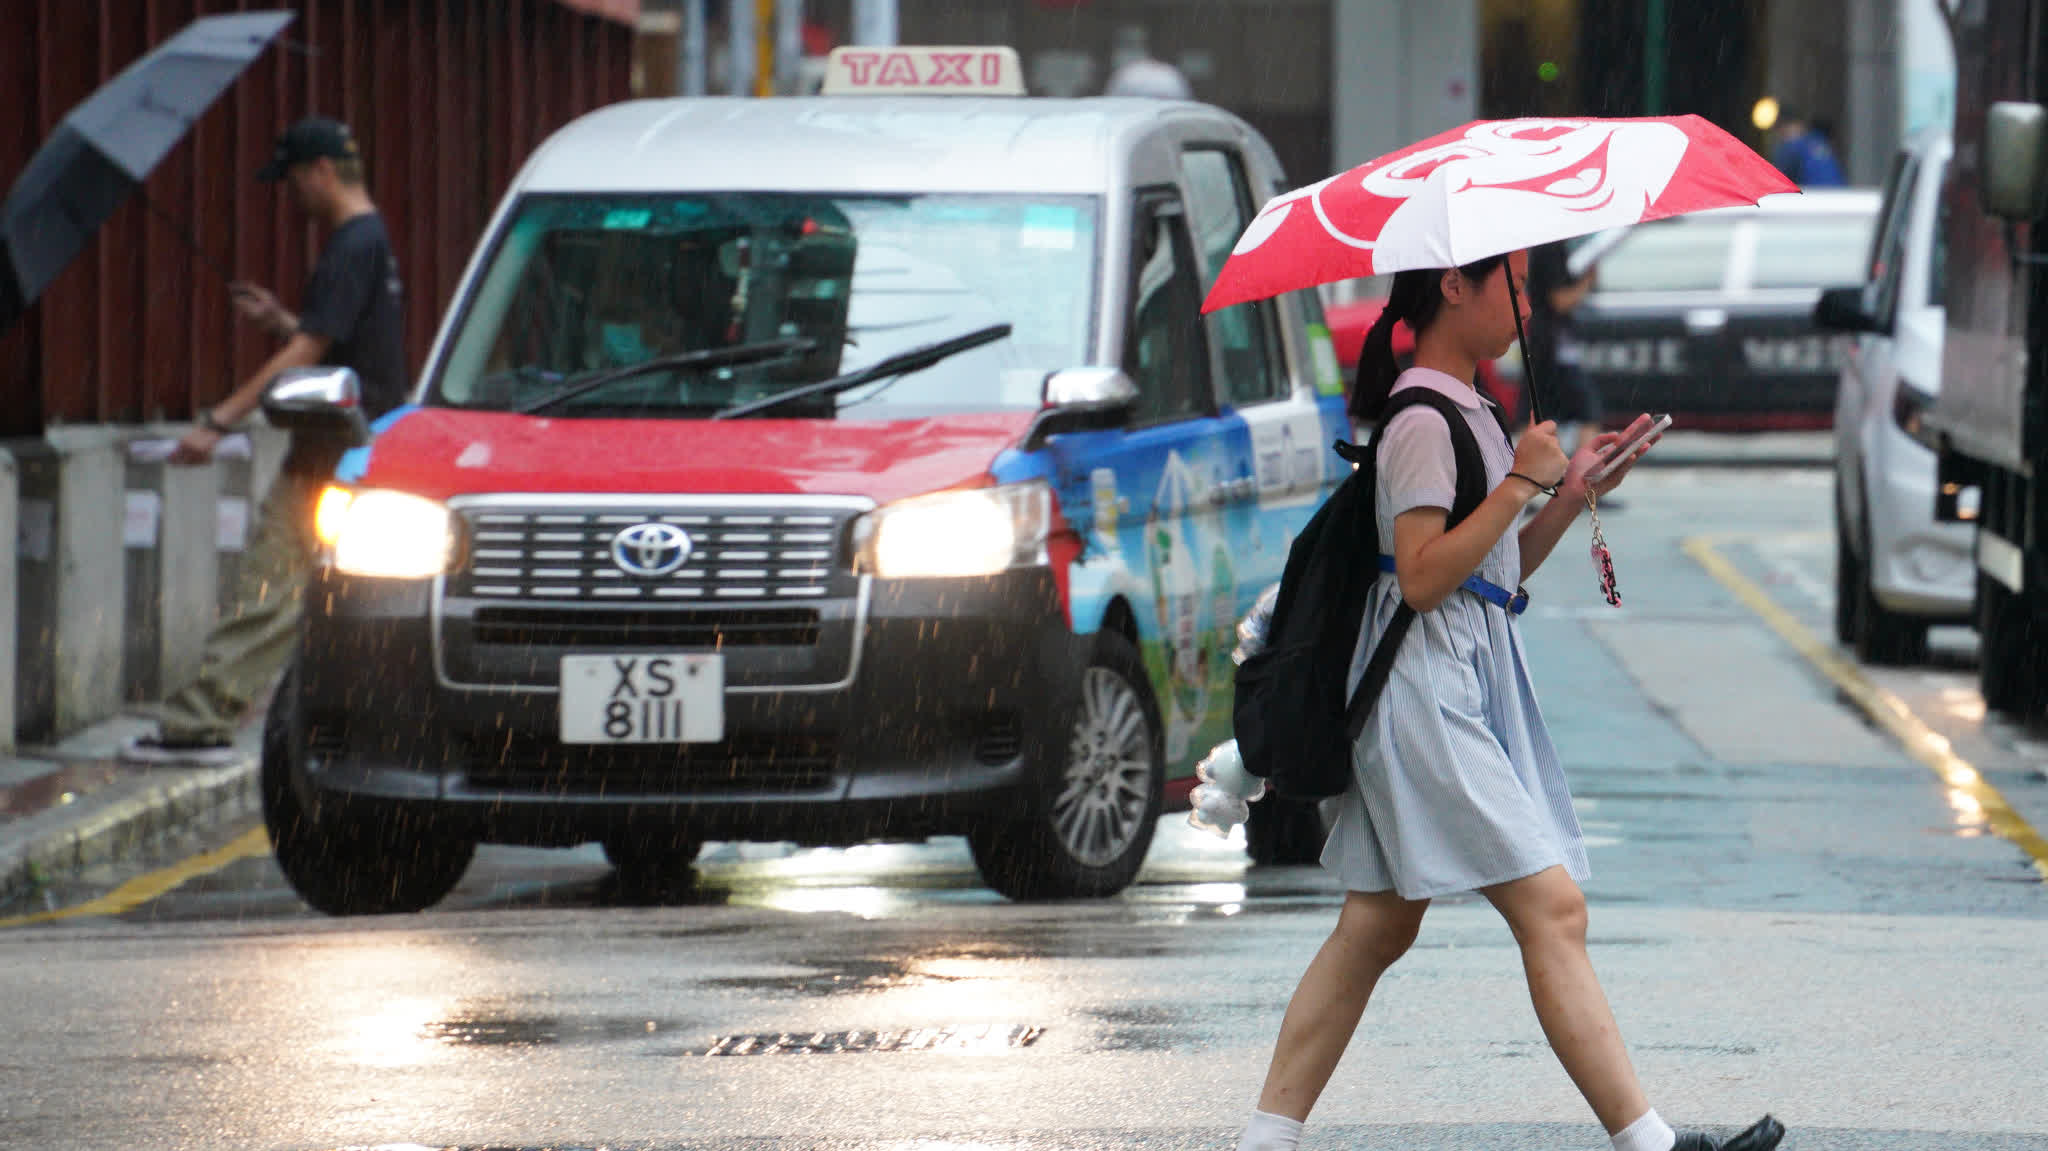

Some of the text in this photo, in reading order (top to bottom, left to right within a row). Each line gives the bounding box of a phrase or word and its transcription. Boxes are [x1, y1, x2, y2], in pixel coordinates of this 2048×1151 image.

[841, 52, 1000, 86] TAXI
[613, 658, 675, 698] XS
[604, 700, 683, 739] 8111
